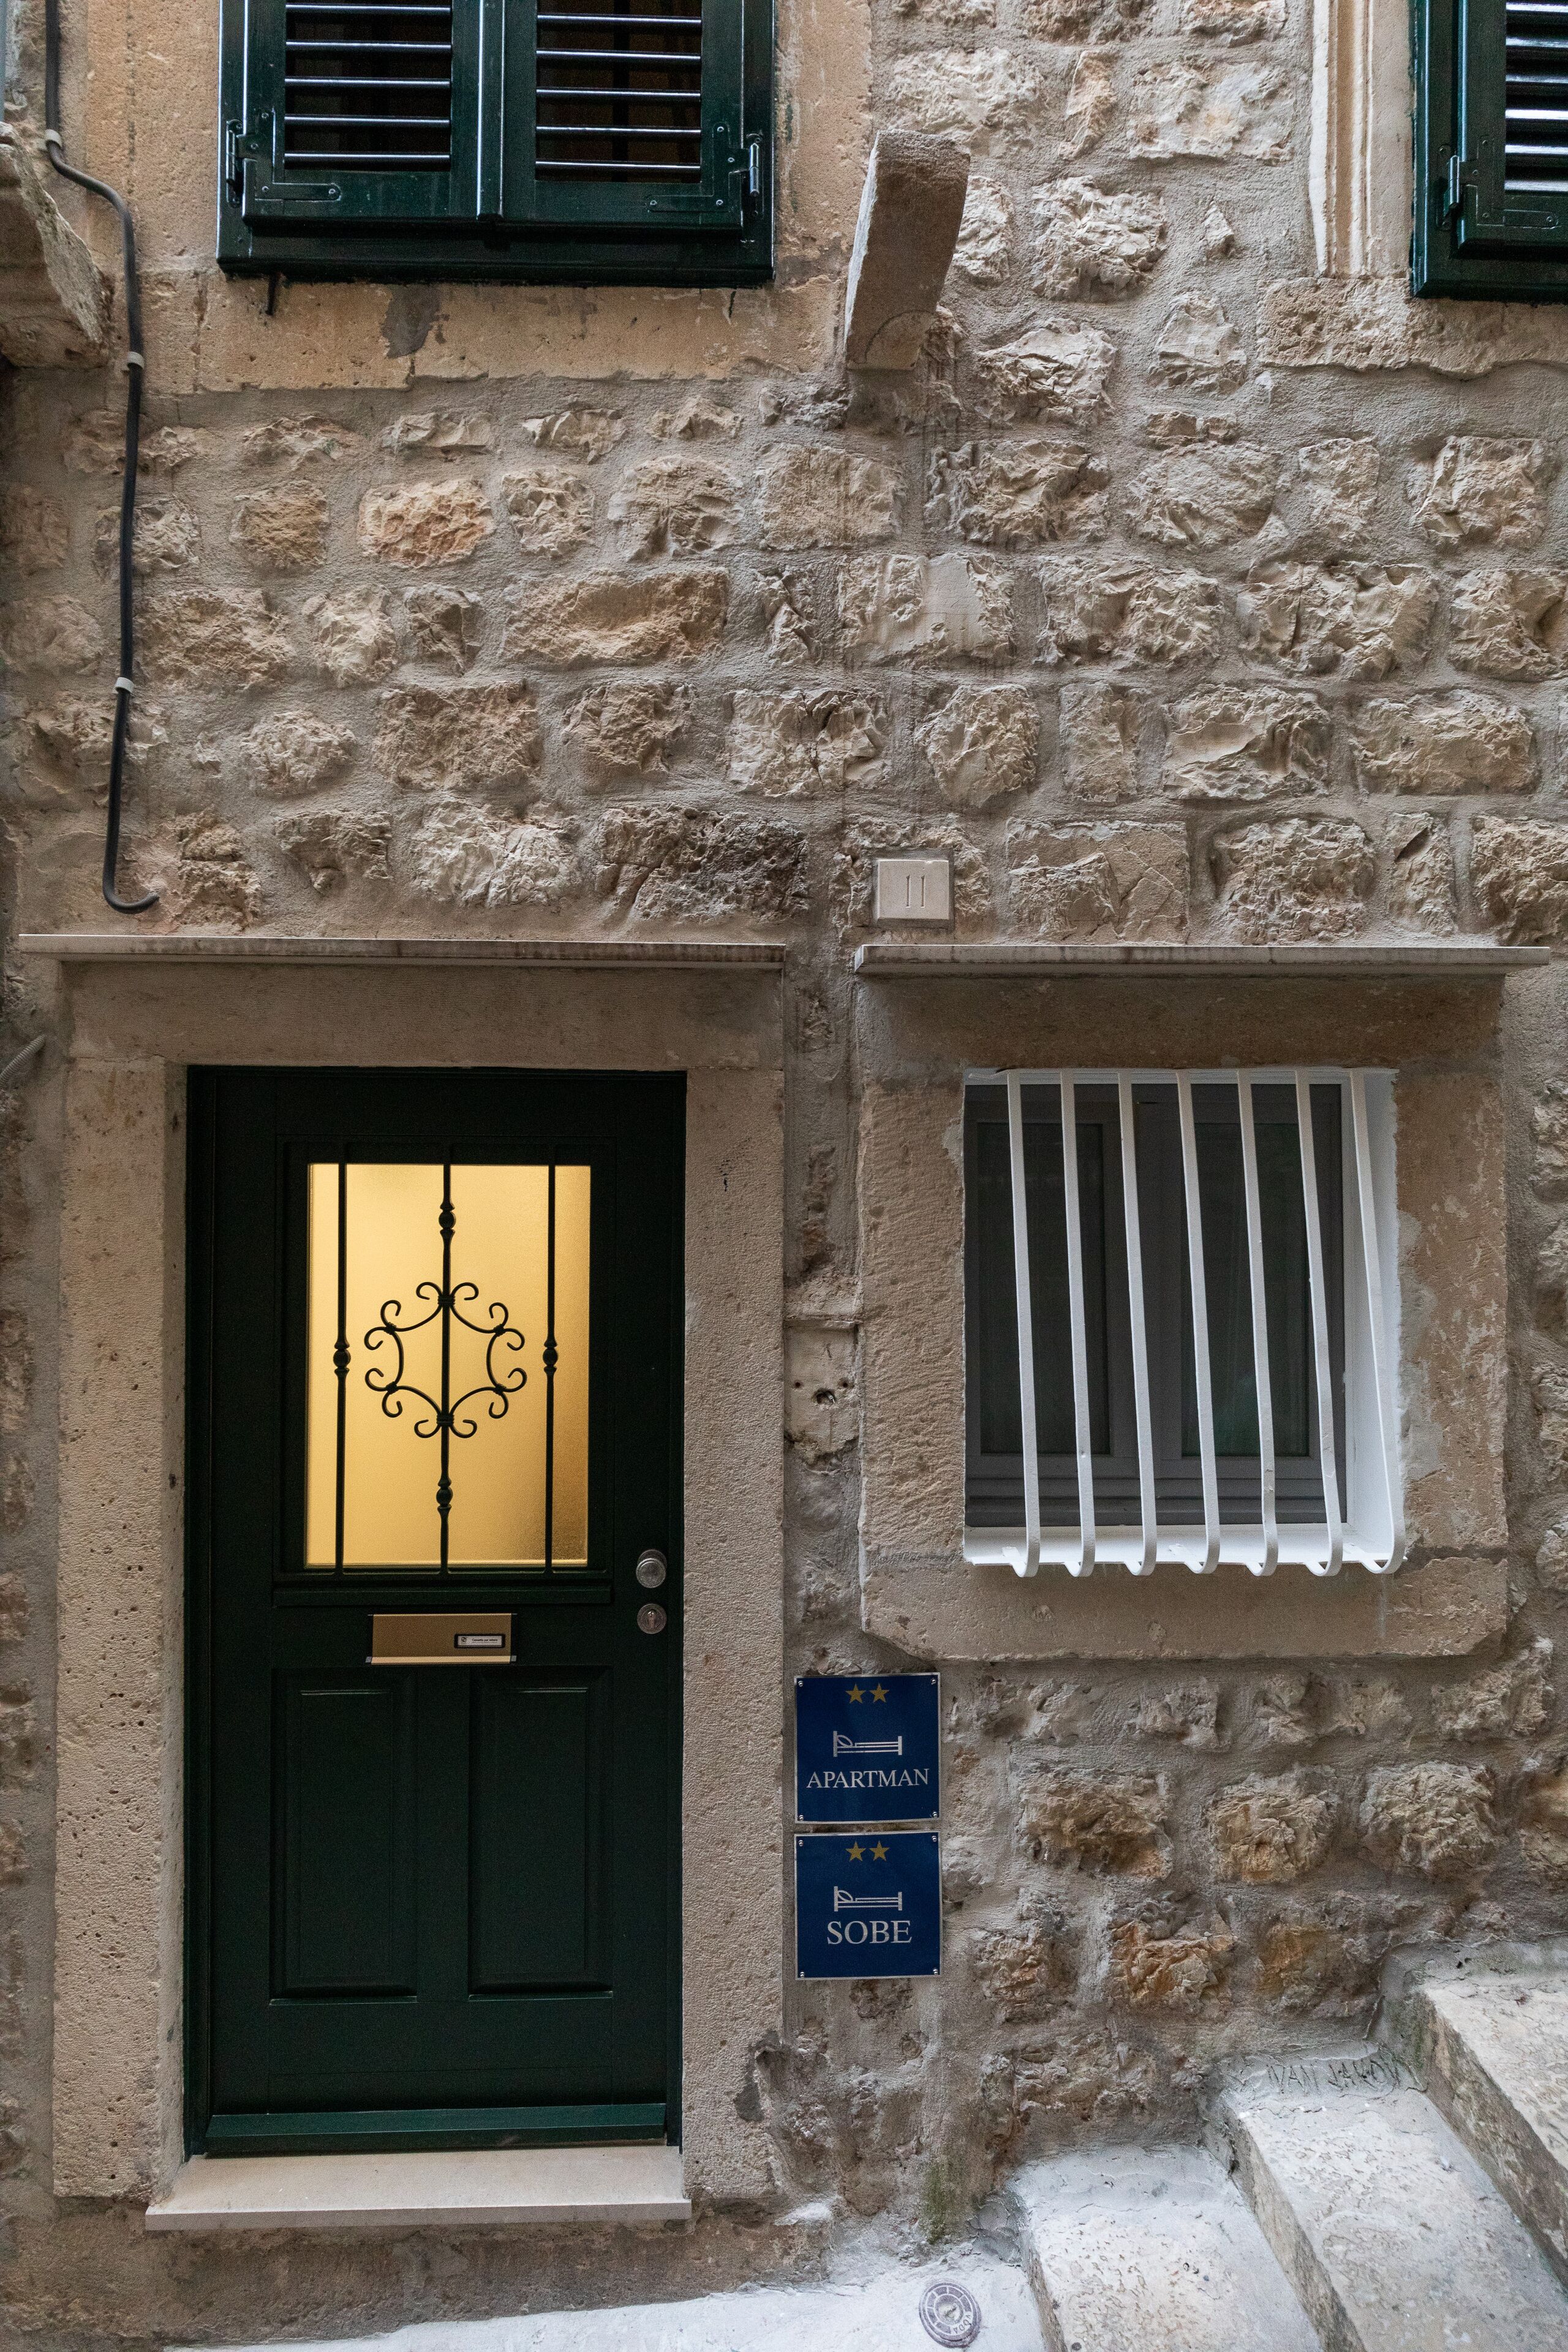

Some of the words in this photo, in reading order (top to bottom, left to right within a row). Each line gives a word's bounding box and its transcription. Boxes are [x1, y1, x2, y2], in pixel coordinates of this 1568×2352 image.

[806, 1768, 930, 1789] APARTMAN
[827, 1920, 913, 1945] SOBE
[953, 2315, 971, 2334] VODA
